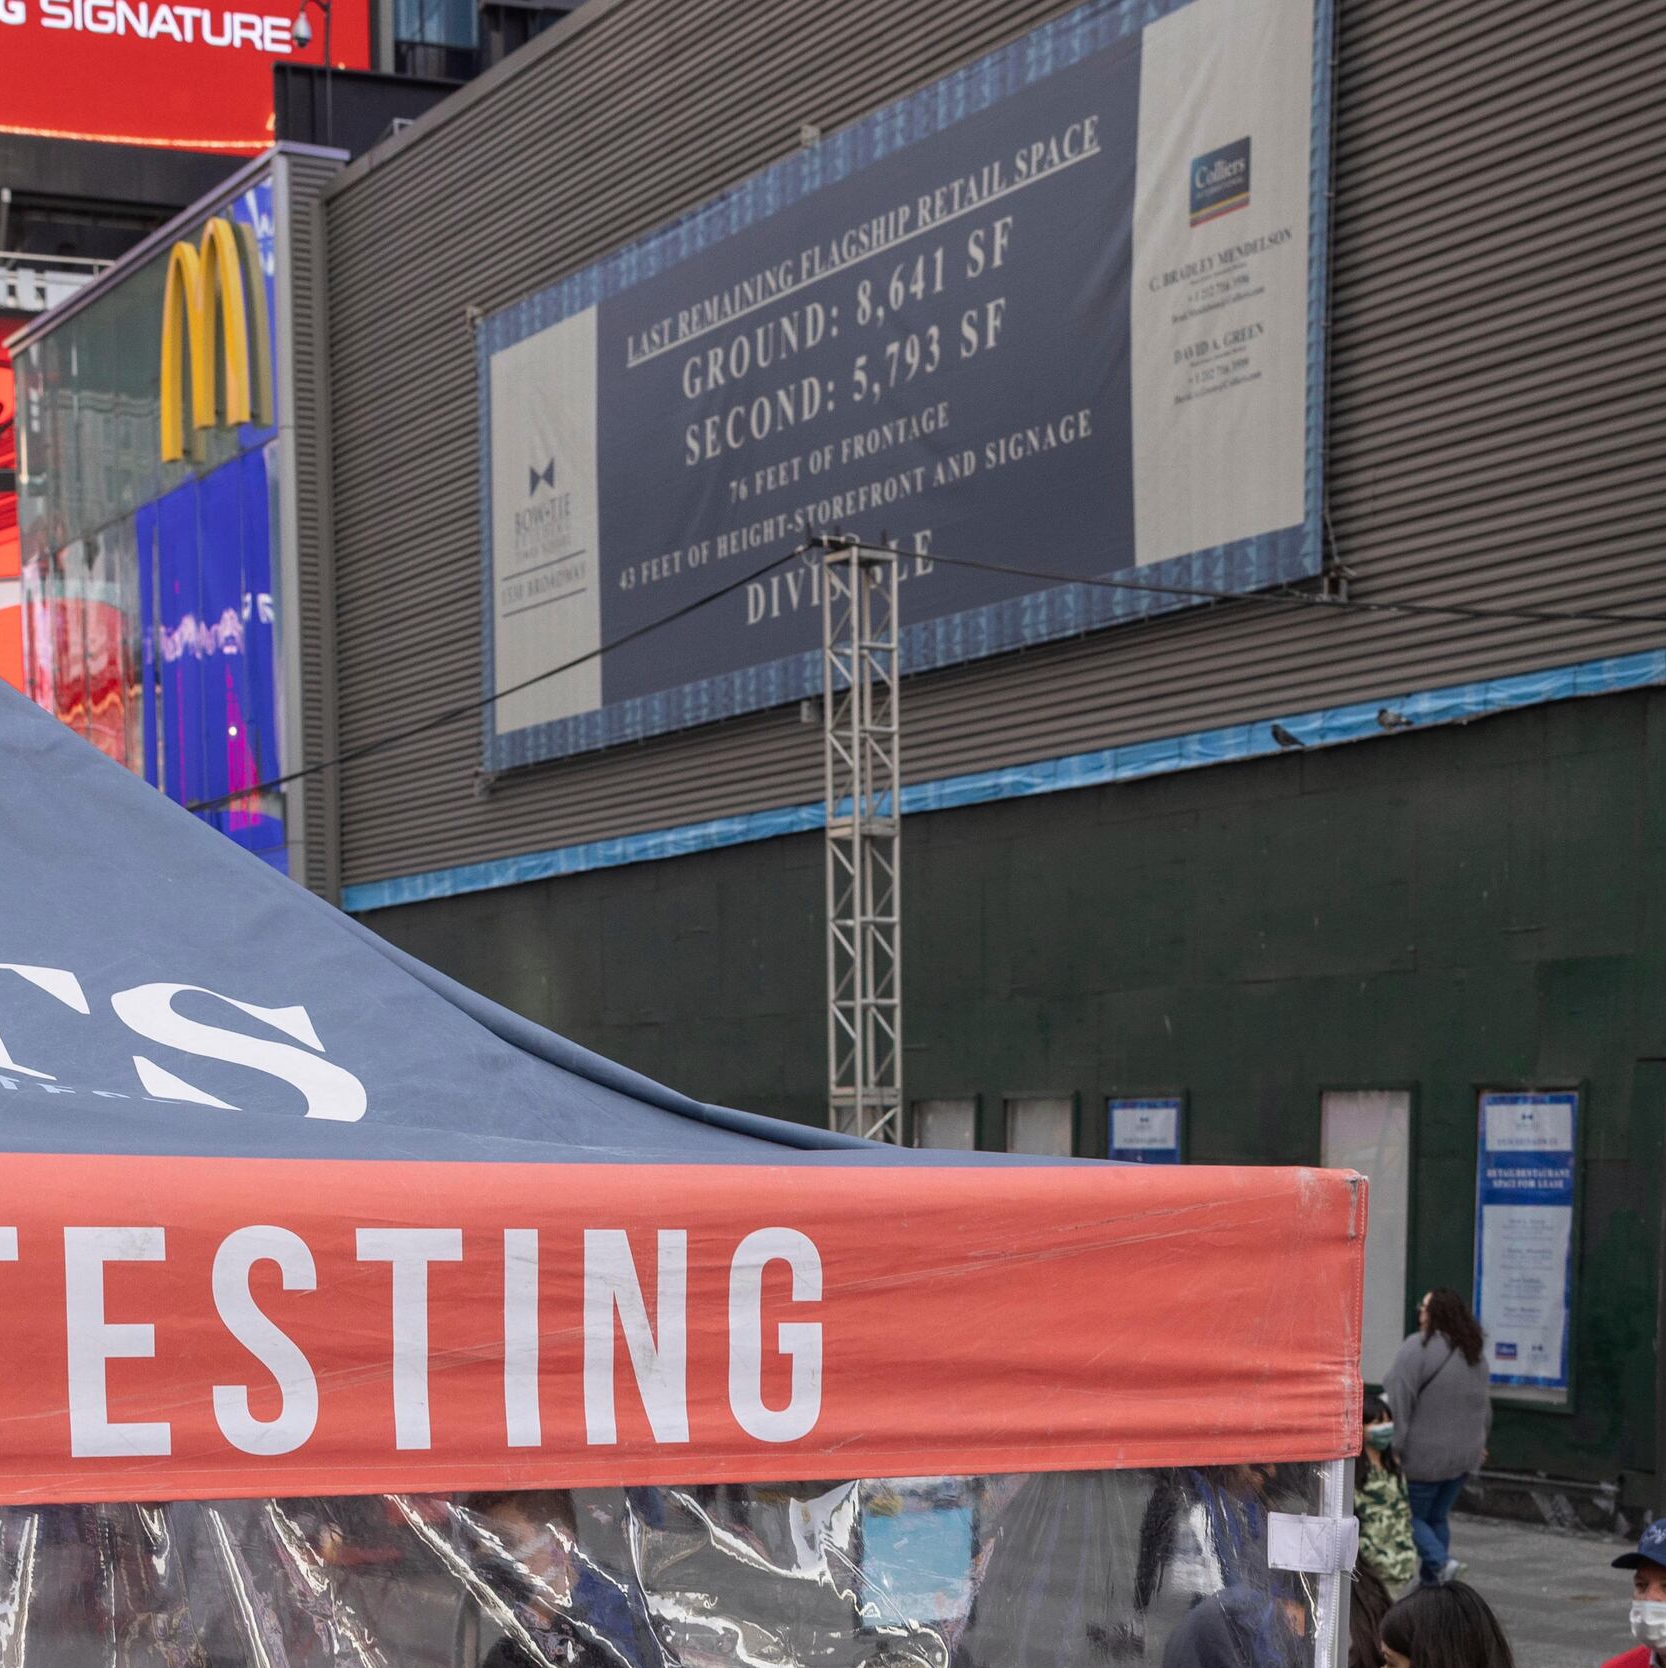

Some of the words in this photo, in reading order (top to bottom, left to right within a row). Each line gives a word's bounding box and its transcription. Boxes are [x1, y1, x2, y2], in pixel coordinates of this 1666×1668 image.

[40, 0, 292, 54] SIGNATURE
[627, 317, 673, 365] LAST
[677, 259, 793, 340] REMAINING
[800, 205, 911, 281] FLAGSHIP
[917, 161, 1007, 228] RETAIL
[1014, 115, 1099, 184] SPACE
[1195, 157, 1245, 189] Colliers
[683, 302, 838, 400] GROUND:
[856, 247, 945, 328] 8,641
[966, 216, 1013, 279] SF
[685, 376, 834, 467] SECOND:
[853, 325, 940, 404] 5,793
[960, 297, 1006, 359] SF
[619, 566, 636, 591] 43
[641, 551, 683, 585] FEET
[688, 541, 711, 568] OF
[716, 466, 926, 559] HEIGHT-STOREFRONT
[932, 450, 976, 488] AND
[985, 409, 1093, 470] SIGNAGE
[729, 478, 749, 503] 76
[755, 456, 802, 496] FEET
[809, 445, 835, 475] OF
[841, 402, 950, 465] FRONTAGE
